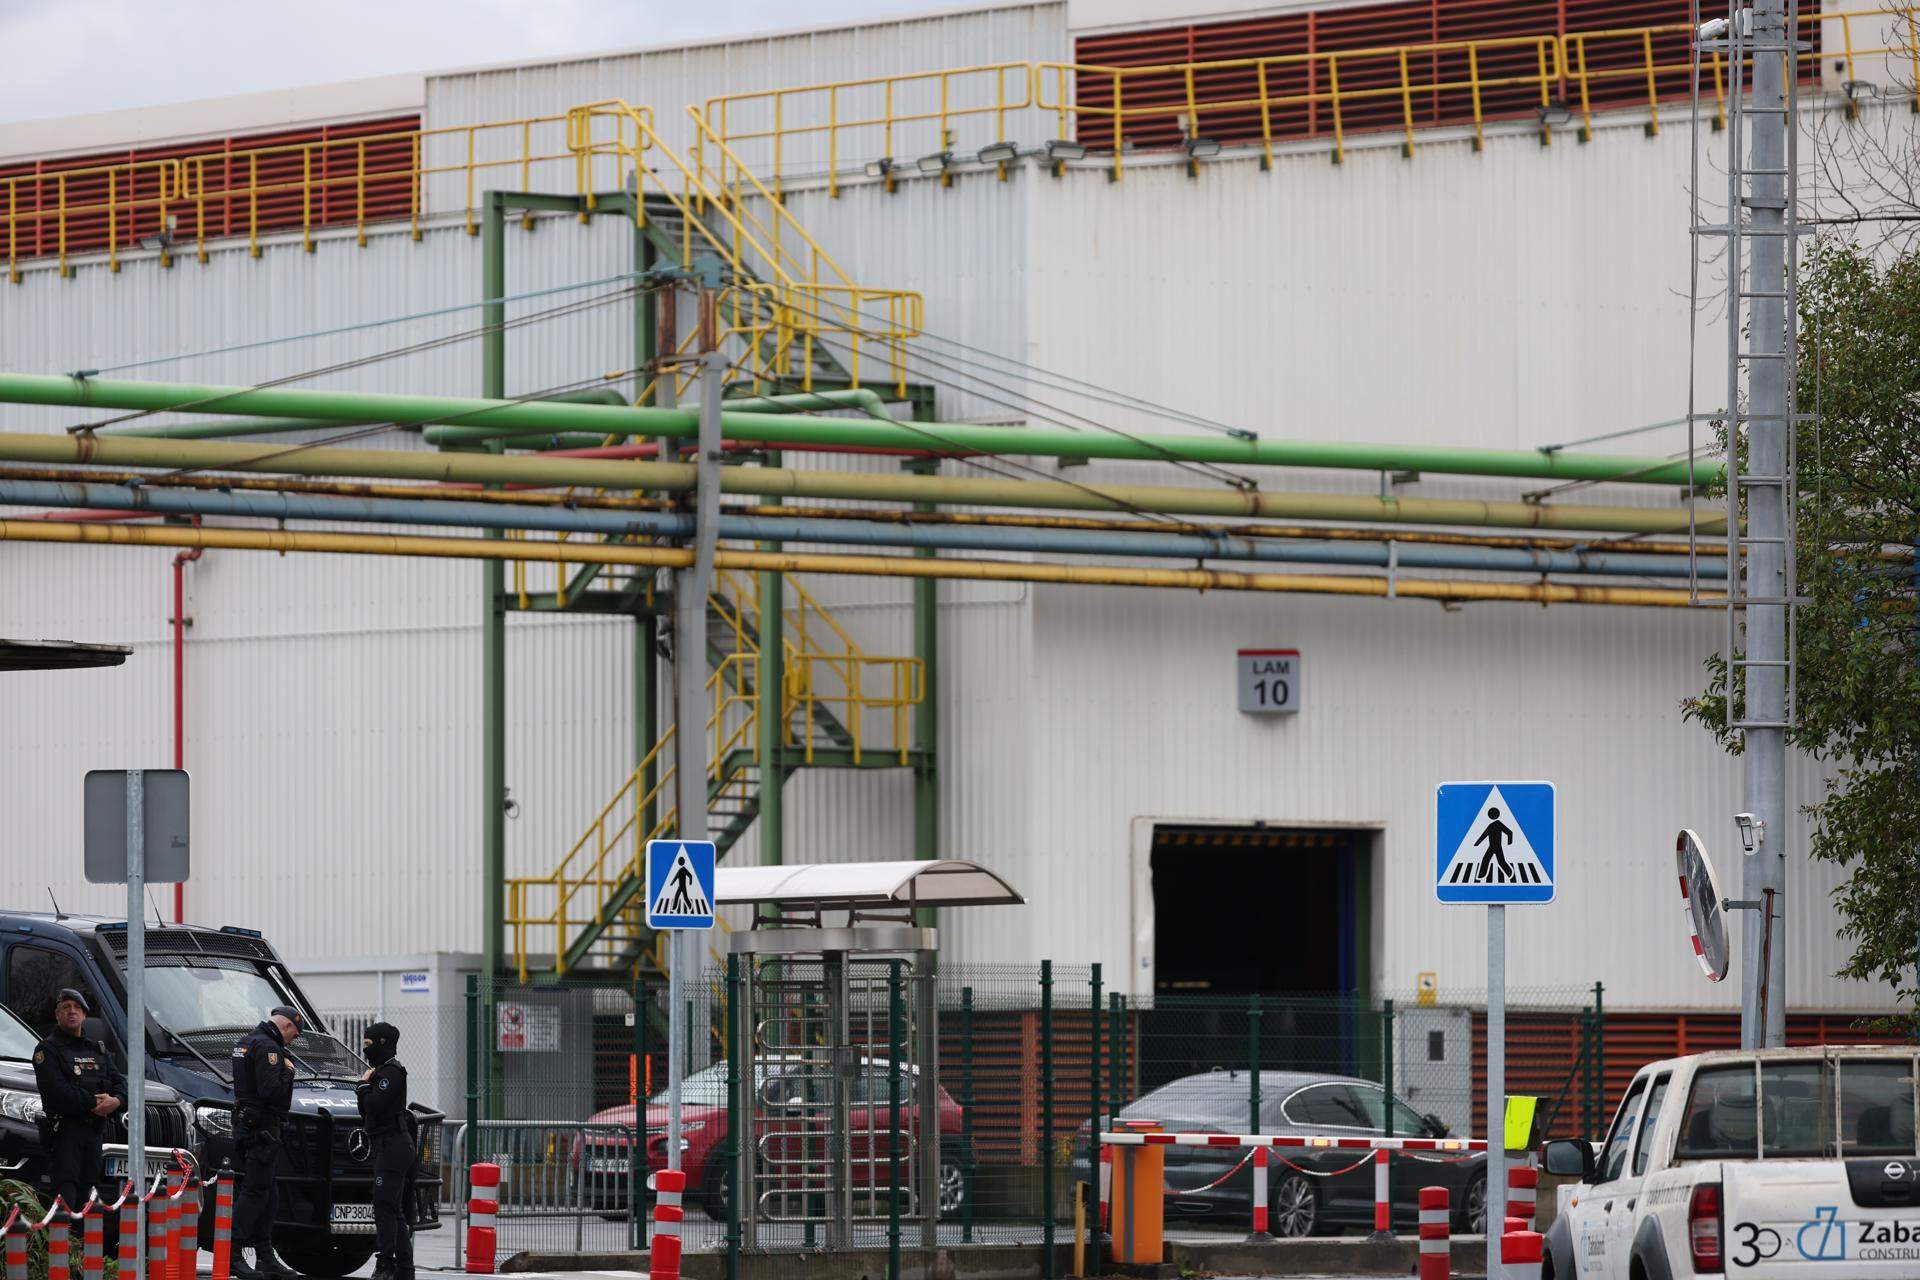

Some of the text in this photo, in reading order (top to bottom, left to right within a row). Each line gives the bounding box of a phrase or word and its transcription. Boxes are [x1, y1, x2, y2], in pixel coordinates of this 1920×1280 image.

[1253, 661, 1290, 675] LAM
[1254, 679, 1289, 706] 10
[1858, 1220, 1920, 1243] Zaba
[1858, 1248, 1920, 1261] CONSTRU
